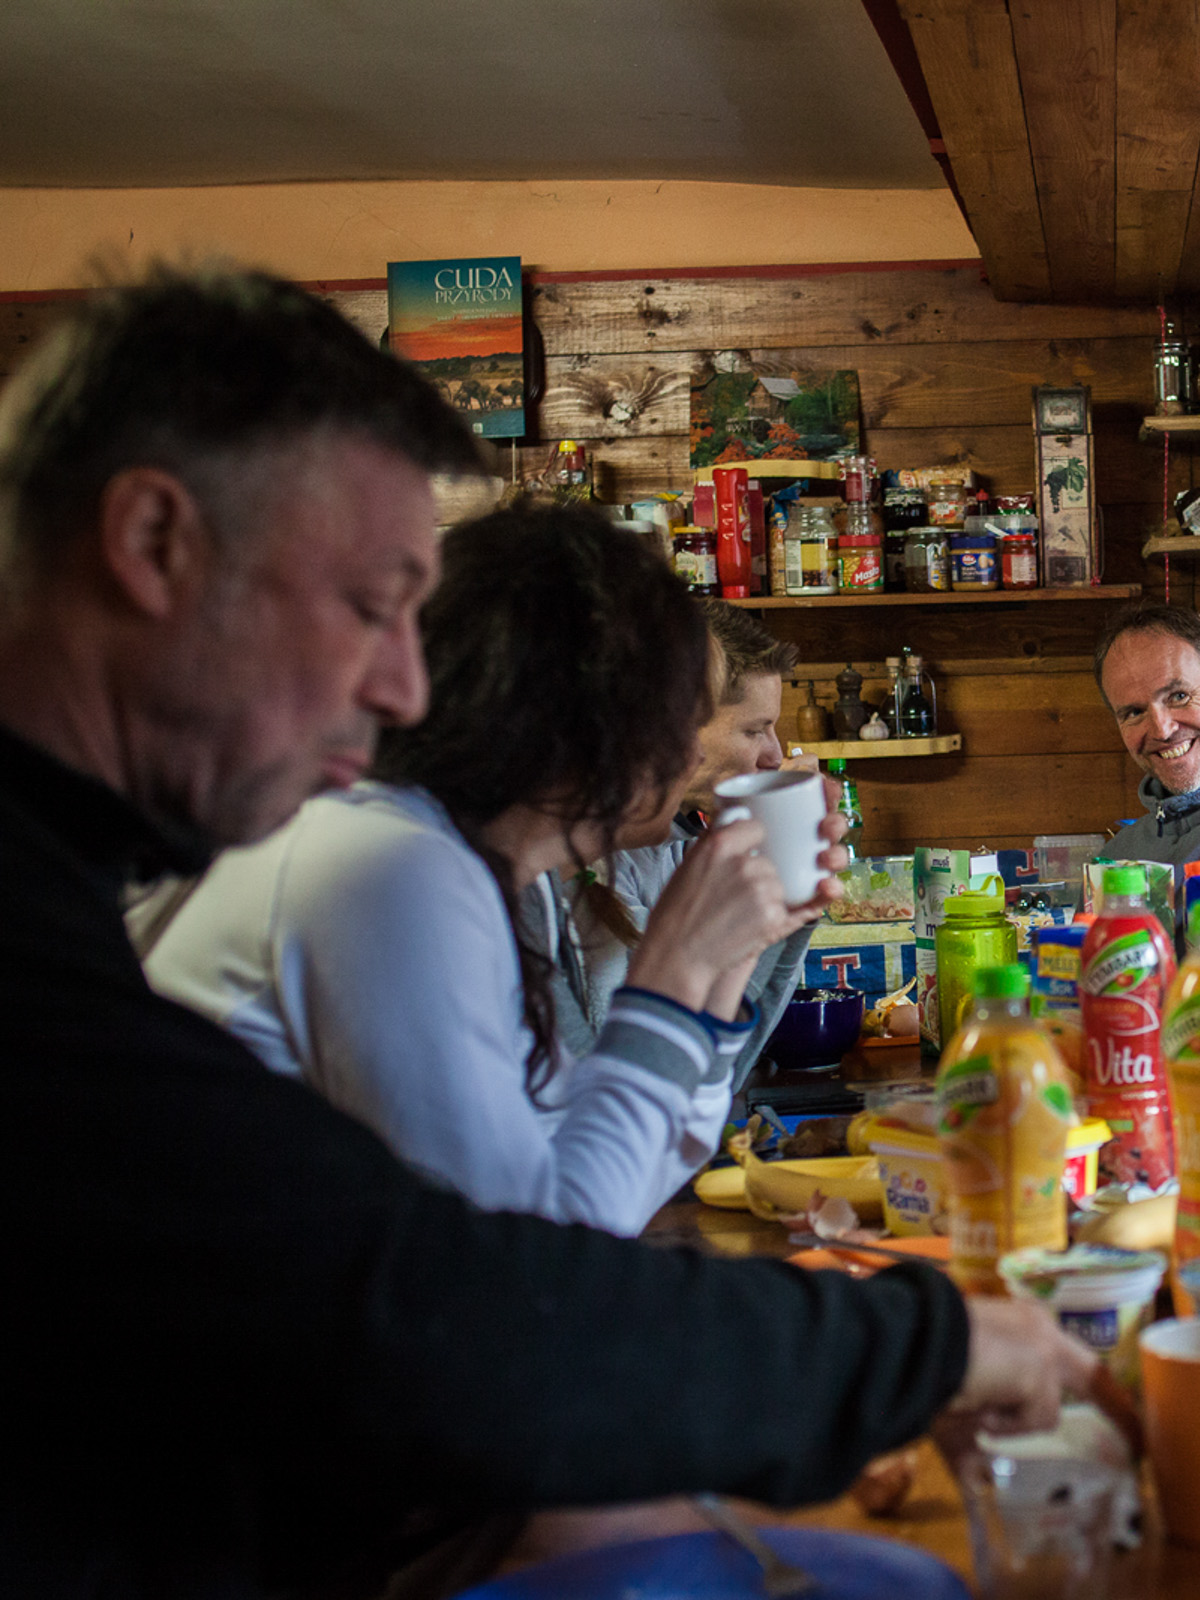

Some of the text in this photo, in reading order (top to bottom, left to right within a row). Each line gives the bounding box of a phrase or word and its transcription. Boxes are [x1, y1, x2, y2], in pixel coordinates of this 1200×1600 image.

[434, 266, 514, 290] CUDA
[435, 287, 514, 305] PRZYRODY
[1090, 1037, 1155, 1085] Vita
